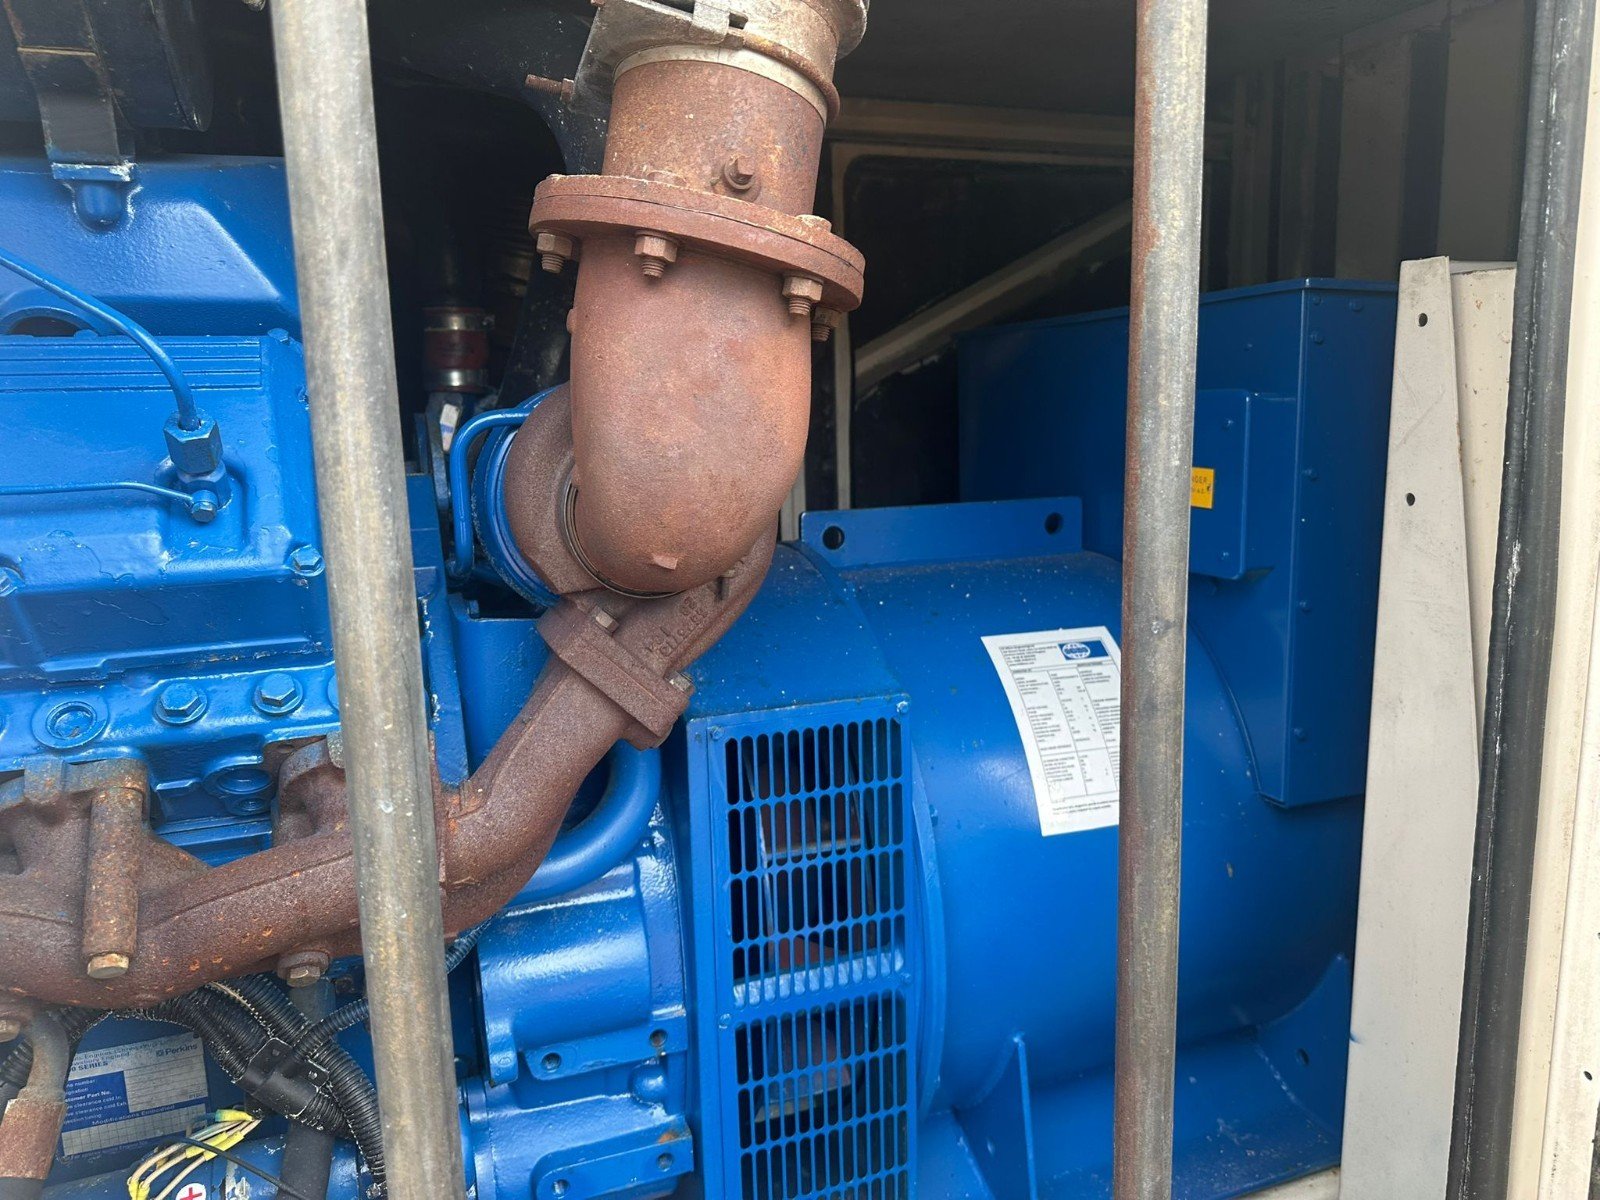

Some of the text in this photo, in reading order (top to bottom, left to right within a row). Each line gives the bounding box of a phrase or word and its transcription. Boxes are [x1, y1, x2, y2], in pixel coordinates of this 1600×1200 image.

[164, 1043, 198, 1056] Perkins
[79, 1061, 109, 1070] SERIES
[91, 1112, 140, 1126] Modifications
